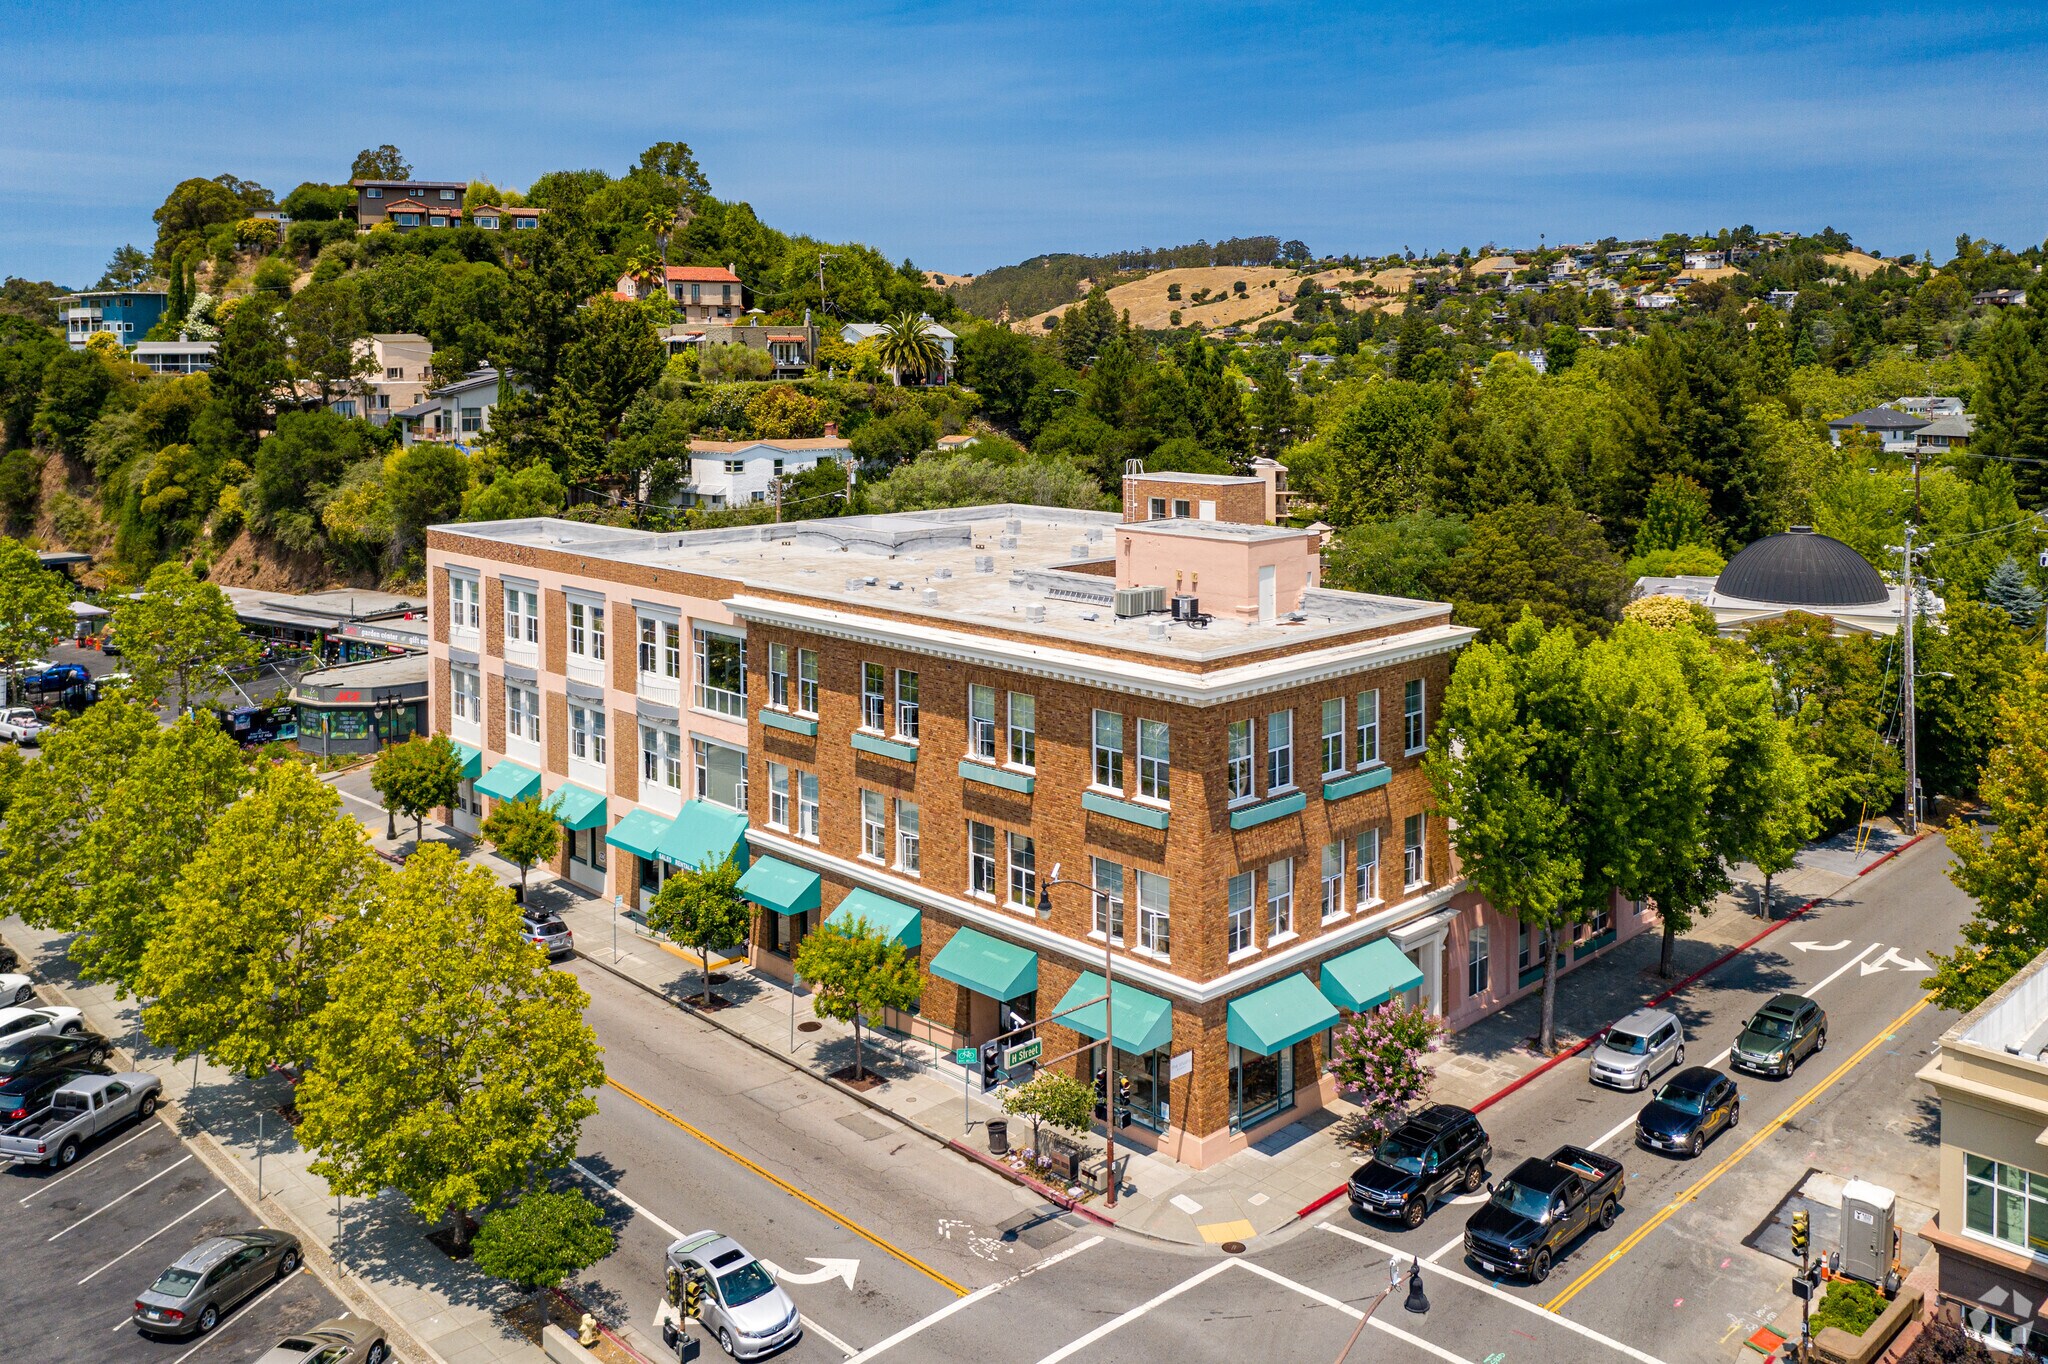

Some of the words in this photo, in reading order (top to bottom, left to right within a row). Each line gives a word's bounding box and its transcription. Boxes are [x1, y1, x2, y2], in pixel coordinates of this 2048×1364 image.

[361, 629, 380, 637] garden
[408, 636, 420, 645] gift
[335, 690, 361, 702] ACE
[659, 853, 672, 863] SALES
[675, 859, 693, 871] RENTALS
[1011, 1053, 1017, 1063] H
[1019, 1045, 1039, 1060] Street
